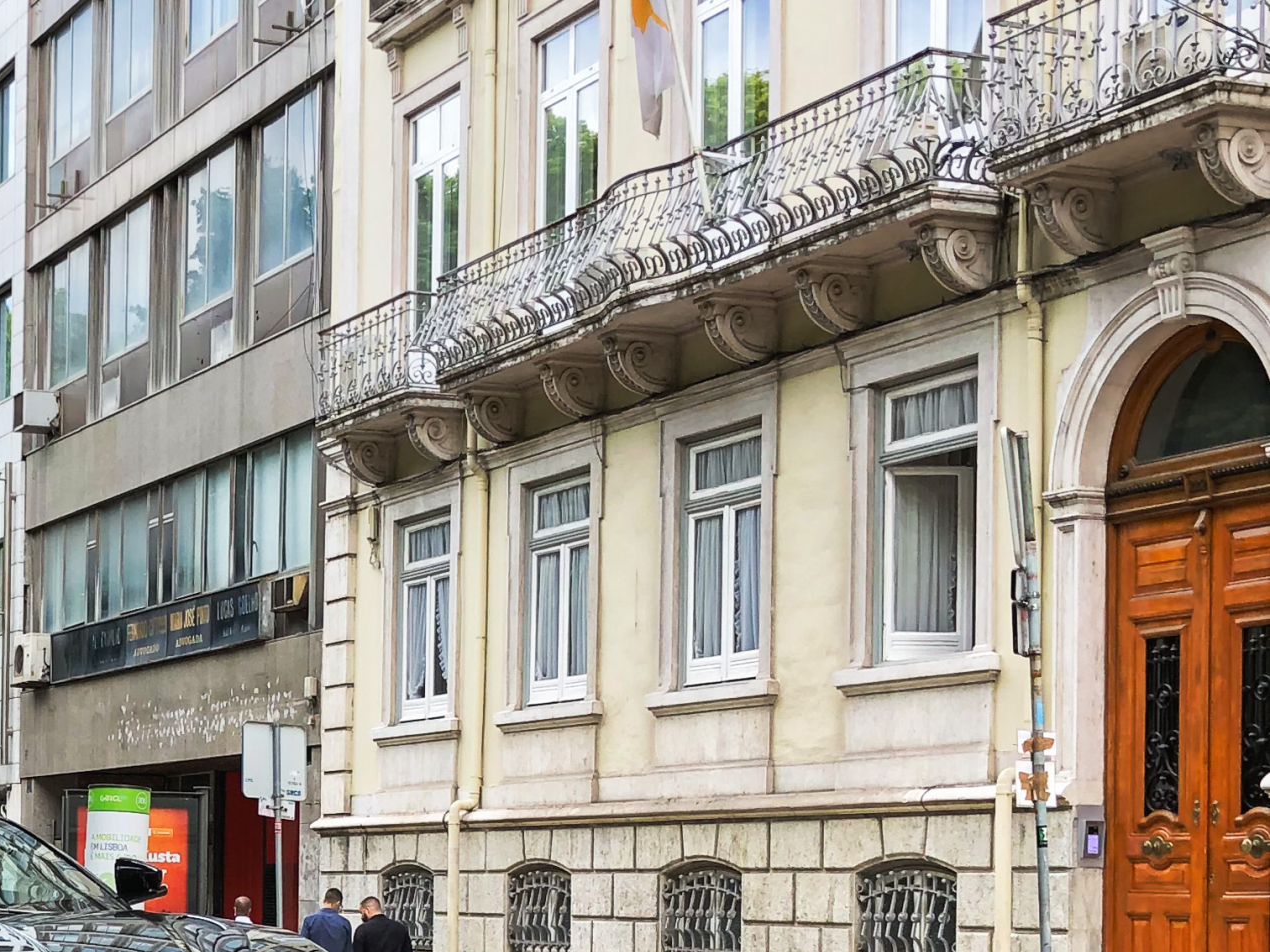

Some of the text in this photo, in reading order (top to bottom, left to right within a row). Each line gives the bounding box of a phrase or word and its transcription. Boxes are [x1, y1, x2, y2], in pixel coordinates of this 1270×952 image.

[96, 833, 142, 843] MOBILIDADE
[100, 843, 128, 851] LISBOA
[95, 852, 115, 860] MAIS
